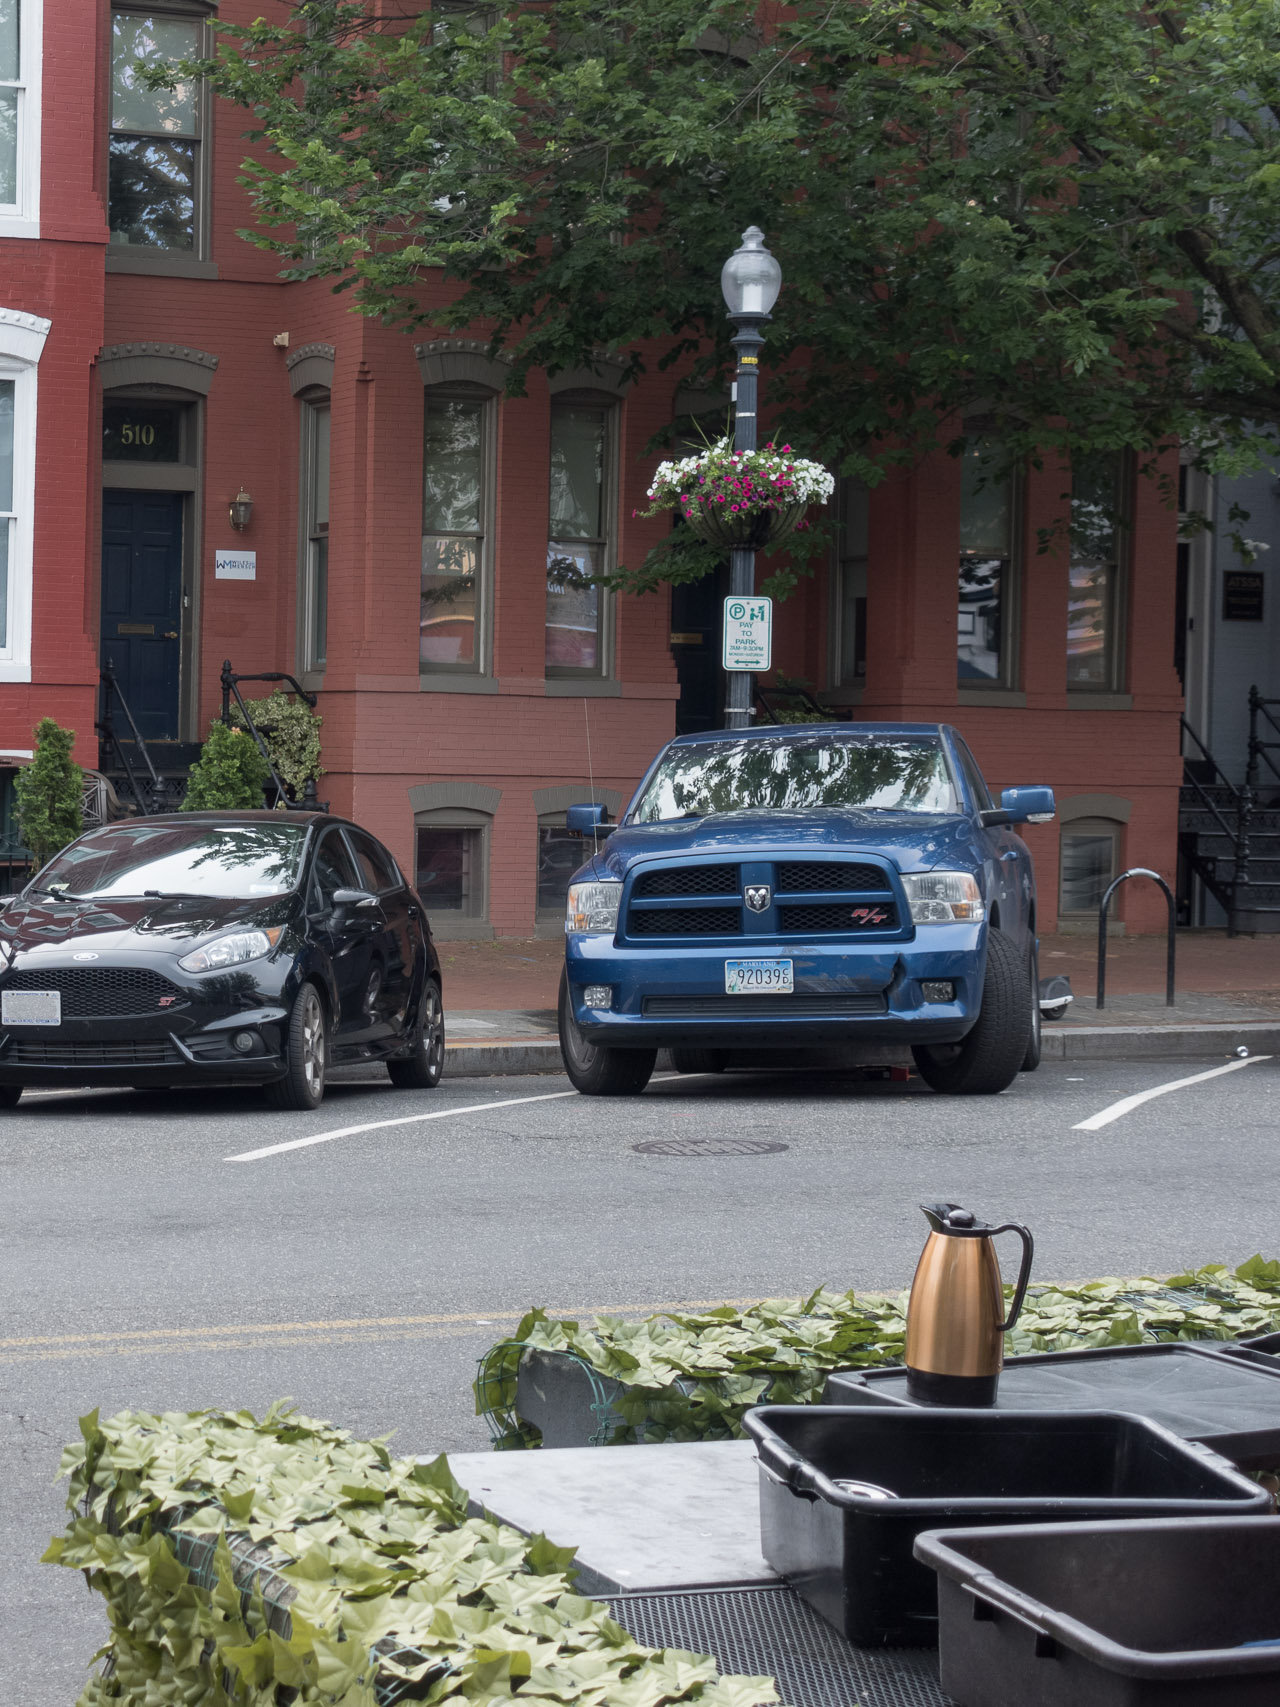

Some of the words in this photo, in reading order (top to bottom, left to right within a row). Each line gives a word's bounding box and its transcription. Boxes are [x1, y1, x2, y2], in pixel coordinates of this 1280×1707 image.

[121, 424, 155, 445] 510
[851, 907, 888, 924] R/T
[158, 996, 176, 1006] ST
